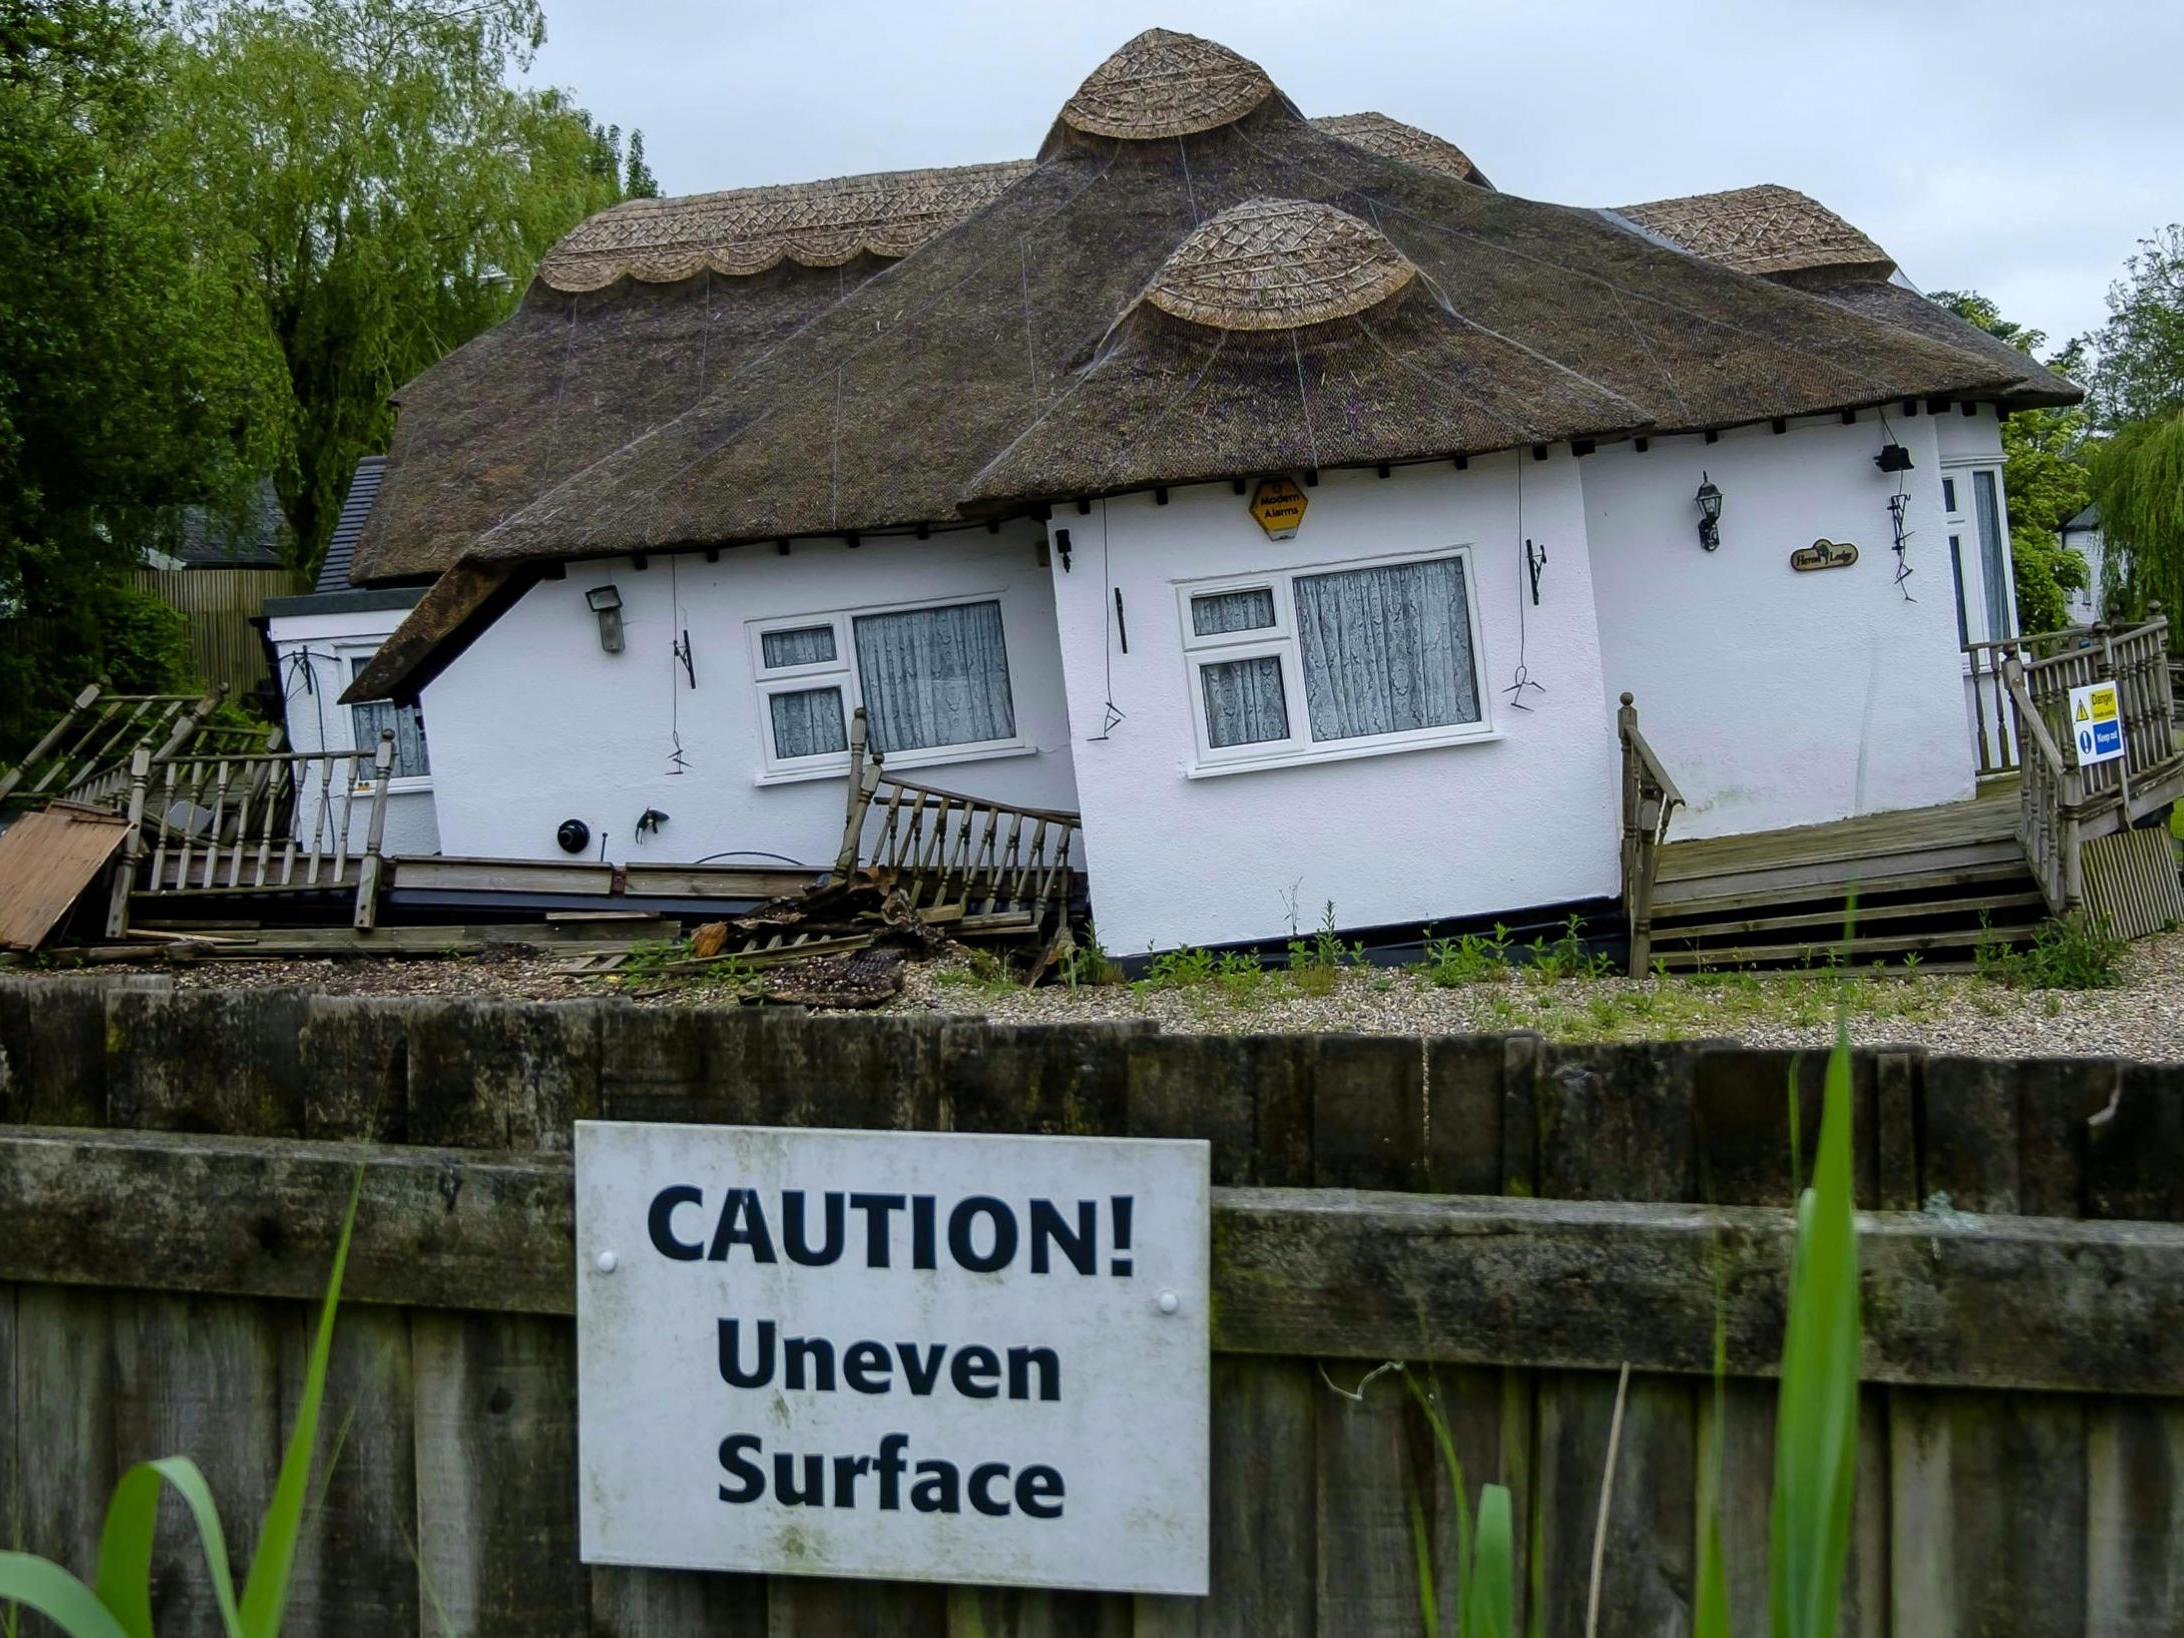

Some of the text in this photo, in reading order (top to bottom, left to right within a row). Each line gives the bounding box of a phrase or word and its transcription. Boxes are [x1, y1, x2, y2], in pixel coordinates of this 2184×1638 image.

[1261, 495, 1300, 506] Modern
[1265, 507, 1299, 518] Alarms
[2091, 693, 2113, 705] Danger
[2097, 733, 2110, 743] Keep
[647, 1185, 1134, 1277] CAUTION!
[717, 1318, 1061, 1401] Uneven
[717, 1433, 1065, 1519] Surface
